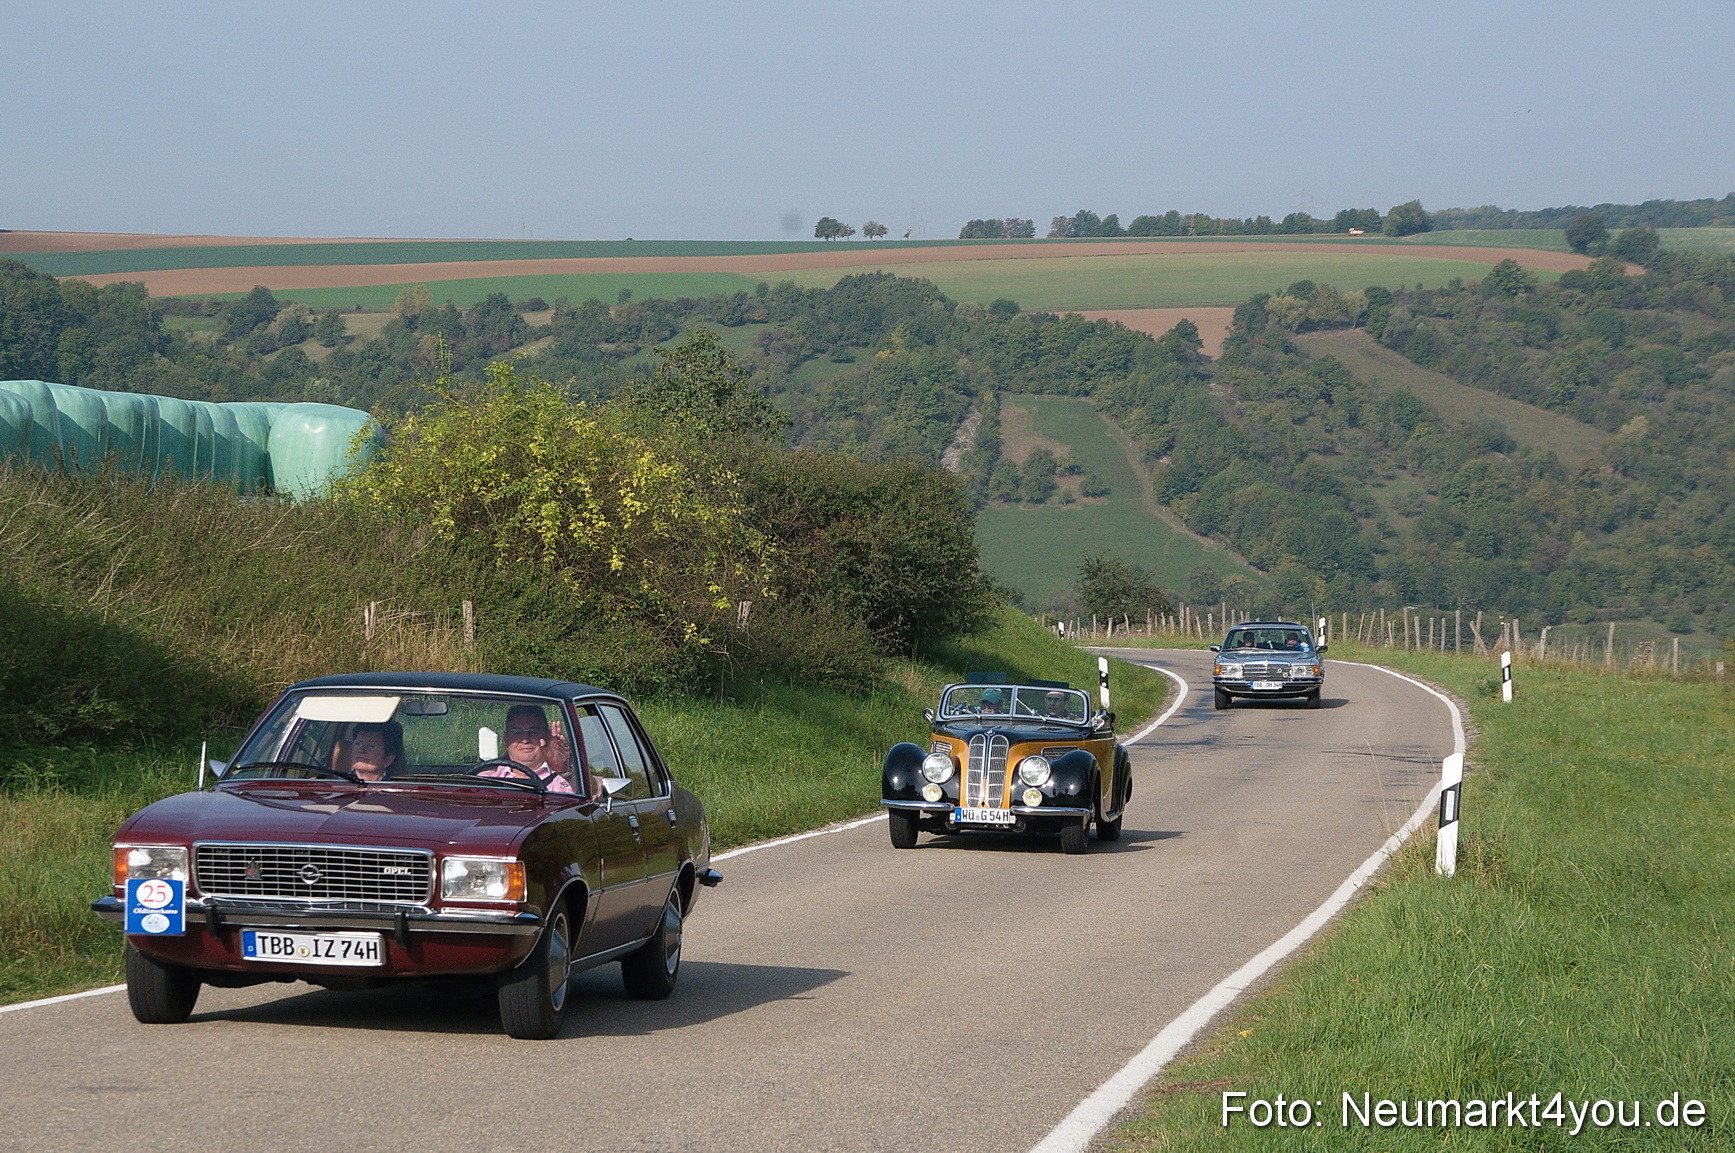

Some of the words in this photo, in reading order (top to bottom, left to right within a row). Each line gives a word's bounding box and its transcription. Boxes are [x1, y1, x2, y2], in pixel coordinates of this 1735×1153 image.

[962, 810, 975, 821] WÜ
[981, 810, 988, 821] G
[989, 811, 1009, 822] 54H
[383, 867, 412, 875] OPEL
[143, 884, 167, 903] 25
[258, 935, 295, 956] TBB
[312, 939, 337, 958] IZ
[341, 940, 379, 960] 74H
